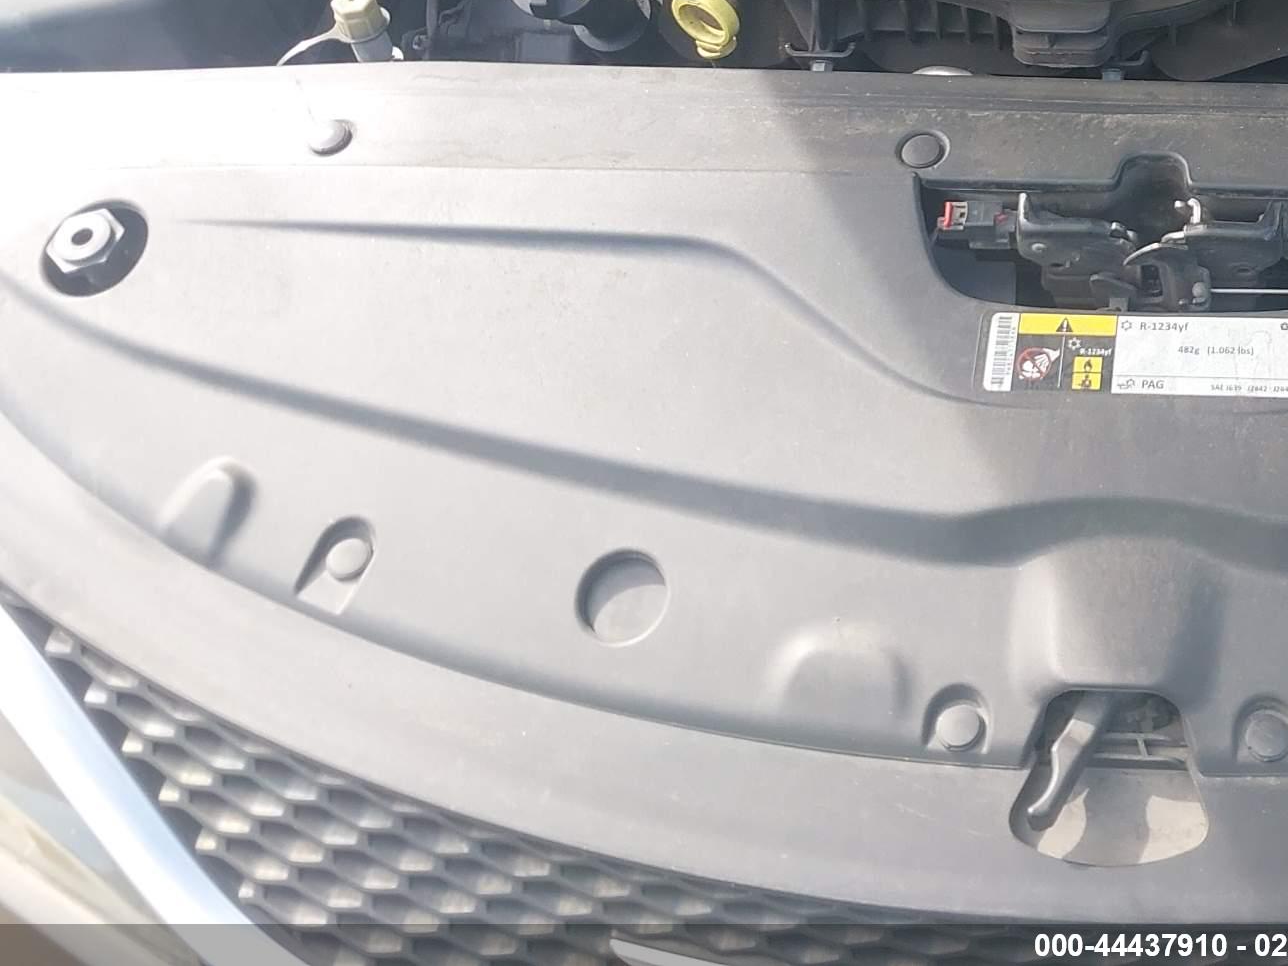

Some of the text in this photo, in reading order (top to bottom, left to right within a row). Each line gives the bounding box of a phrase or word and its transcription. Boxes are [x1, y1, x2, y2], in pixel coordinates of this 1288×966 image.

[1140, 321, 1189, 332] R-1234yf
[1177, 345, 1200, 356] 482g
[1141, 378, 1165, 391] PAG
